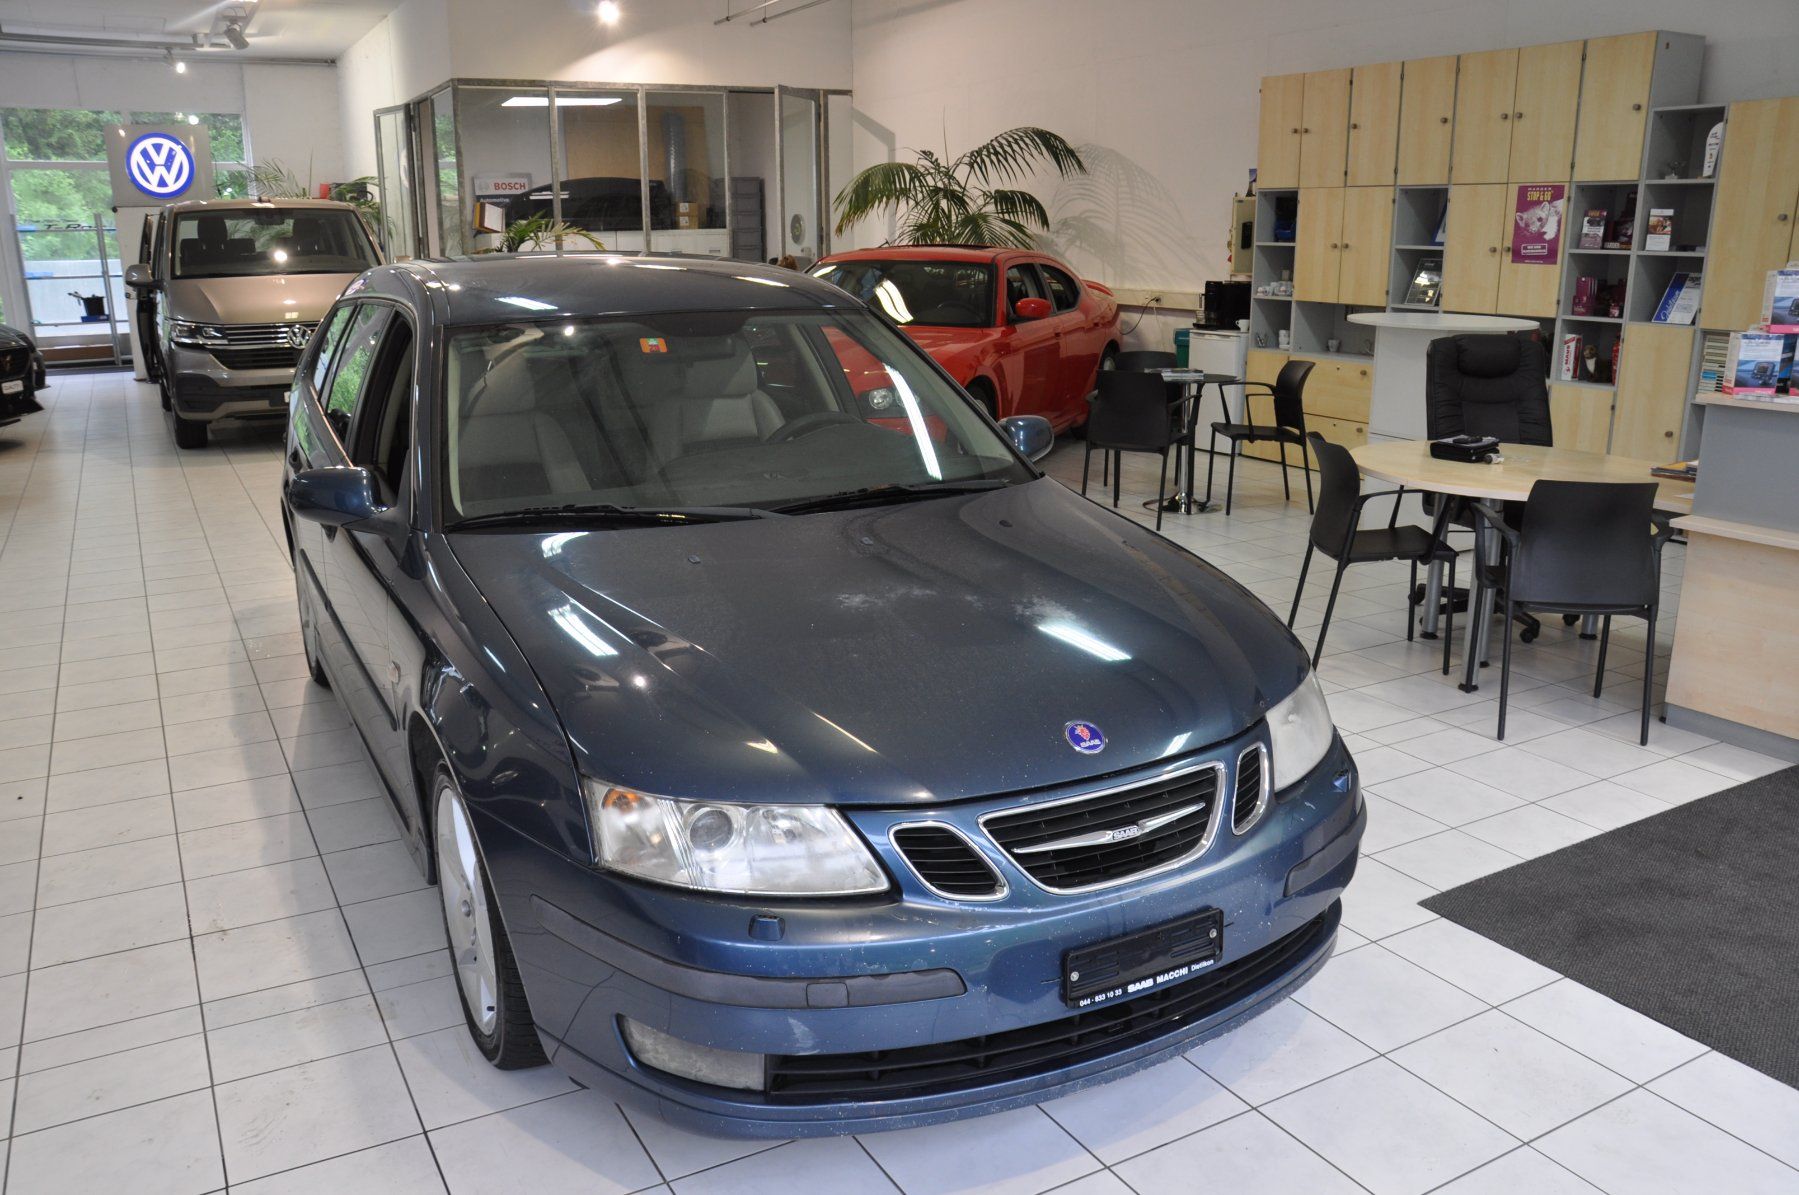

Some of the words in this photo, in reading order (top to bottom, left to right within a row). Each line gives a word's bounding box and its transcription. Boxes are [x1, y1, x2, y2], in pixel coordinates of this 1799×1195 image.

[494, 182, 526, 190] BOSCH
[1527, 191, 1540, 201] STOP
[1112, 826, 1139, 841] SAAB
[1079, 998, 1091, 1007] 044
[1114, 988, 1123, 996] 33
[1127, 978, 1154, 993] SAAB
[1156, 966, 1189, 984] MACCHI
